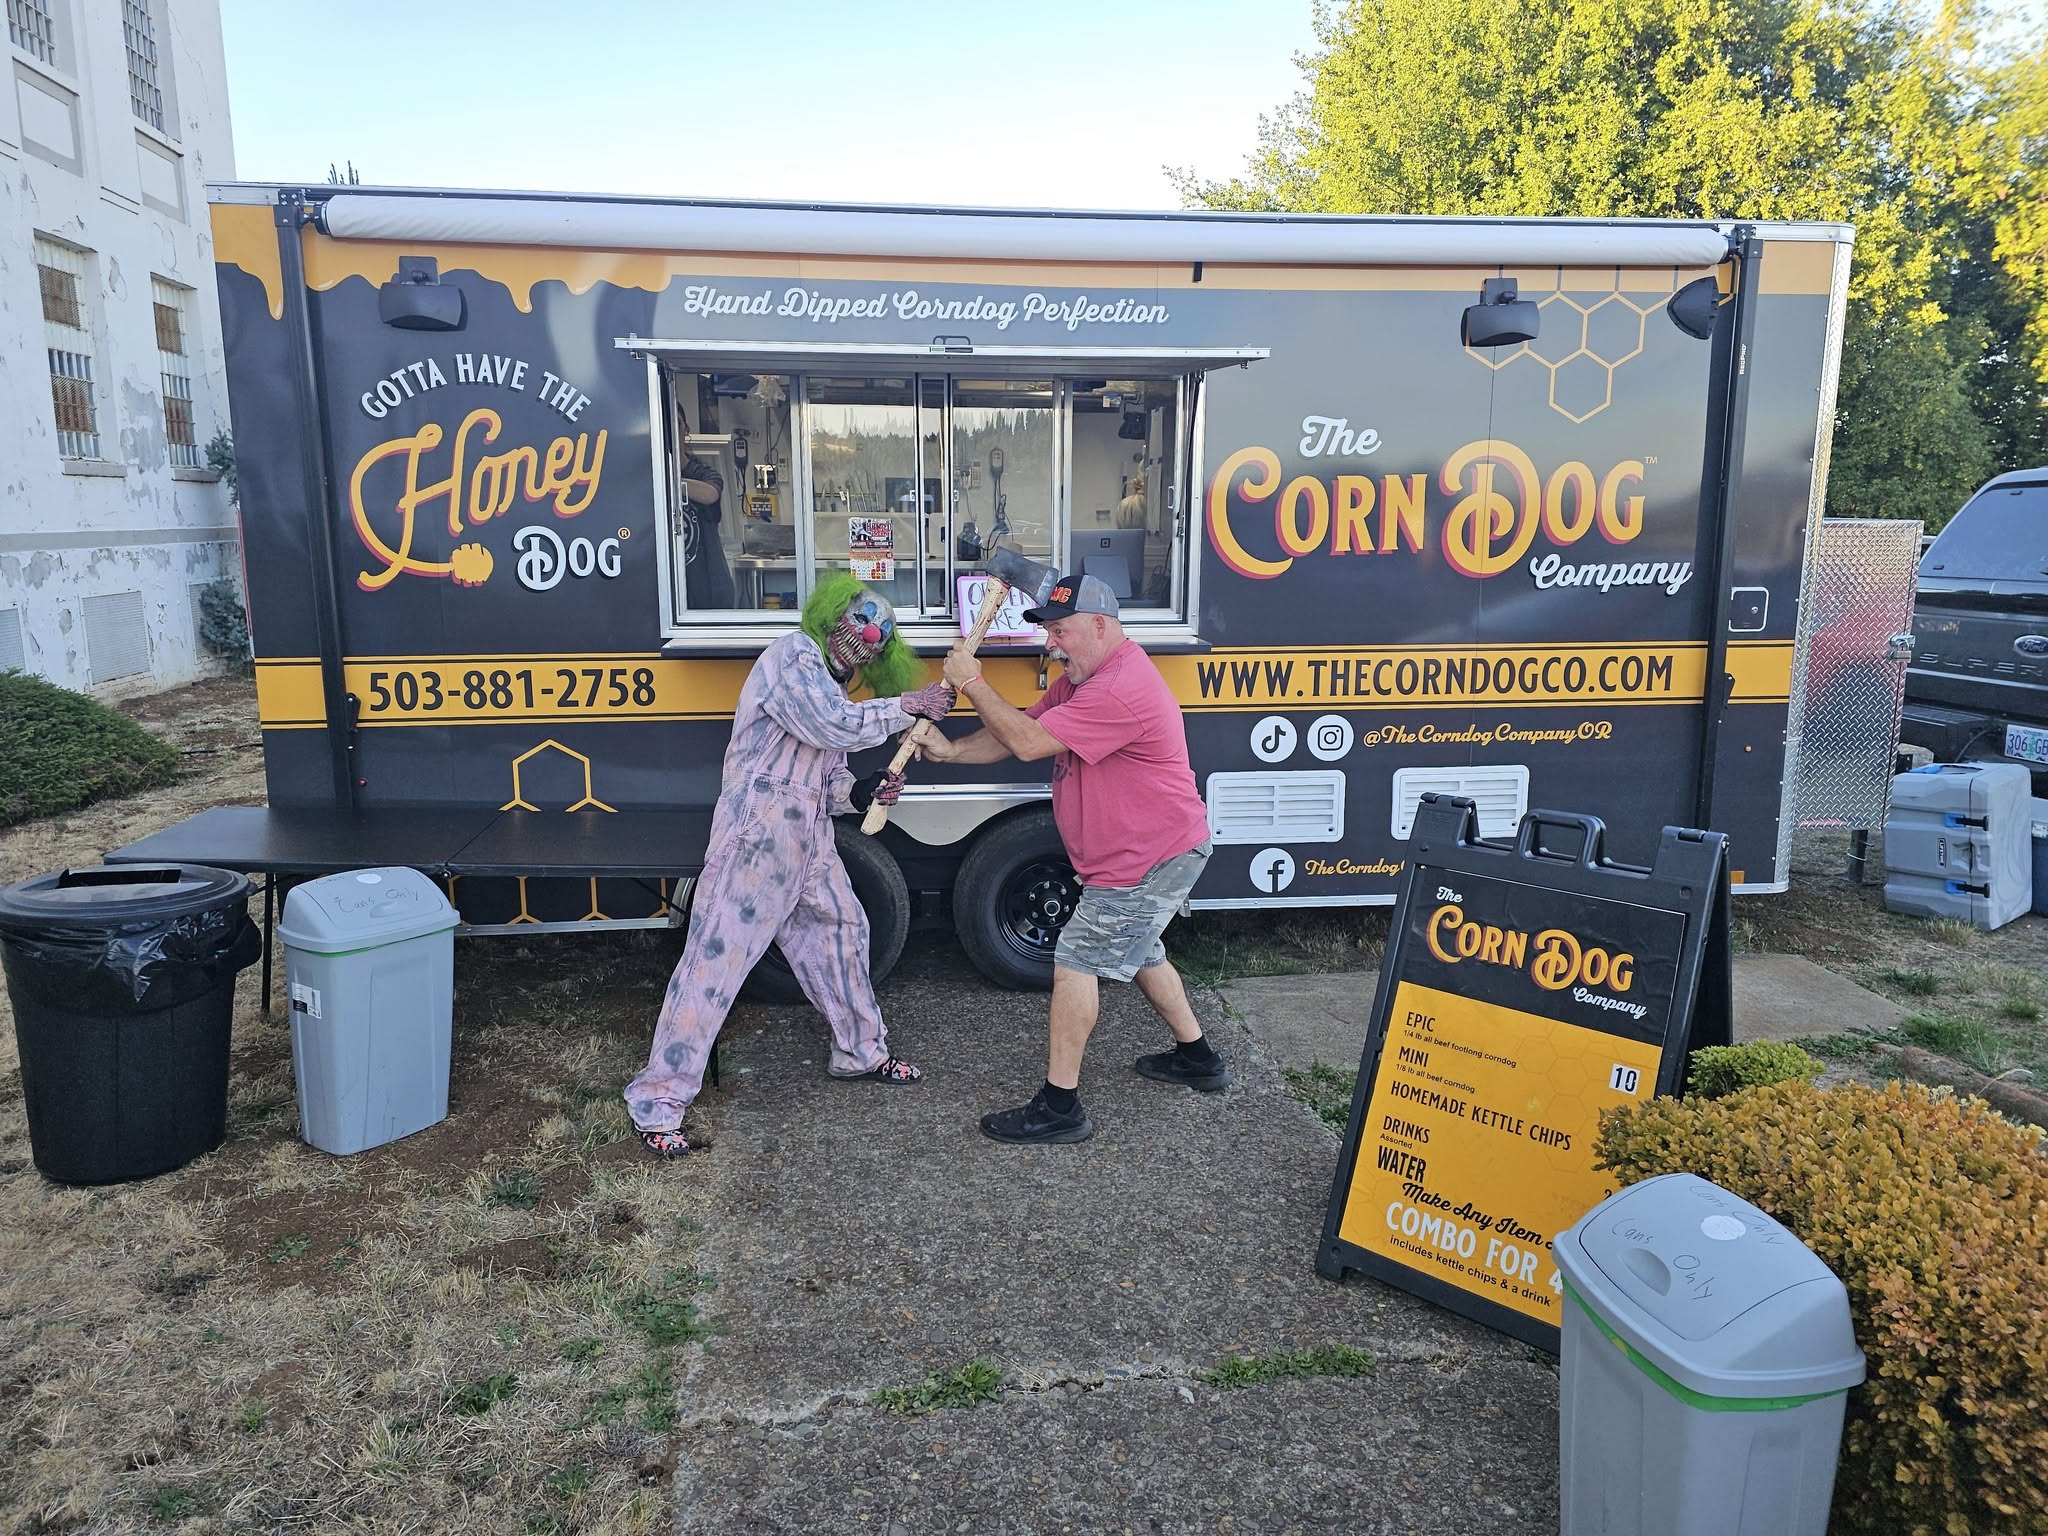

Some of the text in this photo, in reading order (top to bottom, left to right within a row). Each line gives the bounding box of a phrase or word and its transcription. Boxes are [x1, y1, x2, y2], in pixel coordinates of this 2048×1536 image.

[684, 286, 1169, 331] Hand Dipped Corndog Perfection
[361, 354, 591, 422] GOTTA HAVE THE
[1299, 415, 1382, 457] The
[350, 408, 608, 590] Honey
[1208, 447, 1428, 579] CORN
[1530, 554, 1693, 595] Company
[2022, 639, 2047, 653] Ford
[370, 668, 656, 711] 503-881-2758
[1197, 655, 1674, 699] WWW.THECORNDOGCO.COM
[1364, 721, 1613, 747] @TheCorndogCompanyOR
[2007, 733, 2028, 752] 306
[1305, 857, 1405, 877] TheCorndog
[1436, 886, 1464, 903] The
[1427, 905, 1634, 992] CORN DOG
[1406, 1011, 1436, 1032] EPIC
[1573, 986, 1647, 1019] Company
[1398, 1046, 1429, 1067] MINI
[1403, 1029, 1517, 1069] 1/4 lb all beef footlong corndog
[1396, 1063, 1476, 1094] 1/8 lb all beef corndog
[1615, 1067, 1637, 1092] 10
[1382, 1115, 1431, 1144] DRINKS
[1390, 1080, 1572, 1151] HOMEMADE KETTLE CHIPS
[1380, 1133, 1413, 1149] Assorted
[1377, 1145, 1428, 1183] WATER
[1401, 1182, 1451, 1212] Make
[1453, 1202, 1493, 1231] Any
[1494, 1217, 1544, 1246] Item
[1689, 1185, 1784, 1245] Cans Only
[1386, 1201, 1476, 1258] COMBO
[1485, 1237, 1538, 1285] FOR
[1611, 1219, 1715, 1300] Cans Only
[1390, 1234, 1551, 1308] includes kettle chips & a drink
